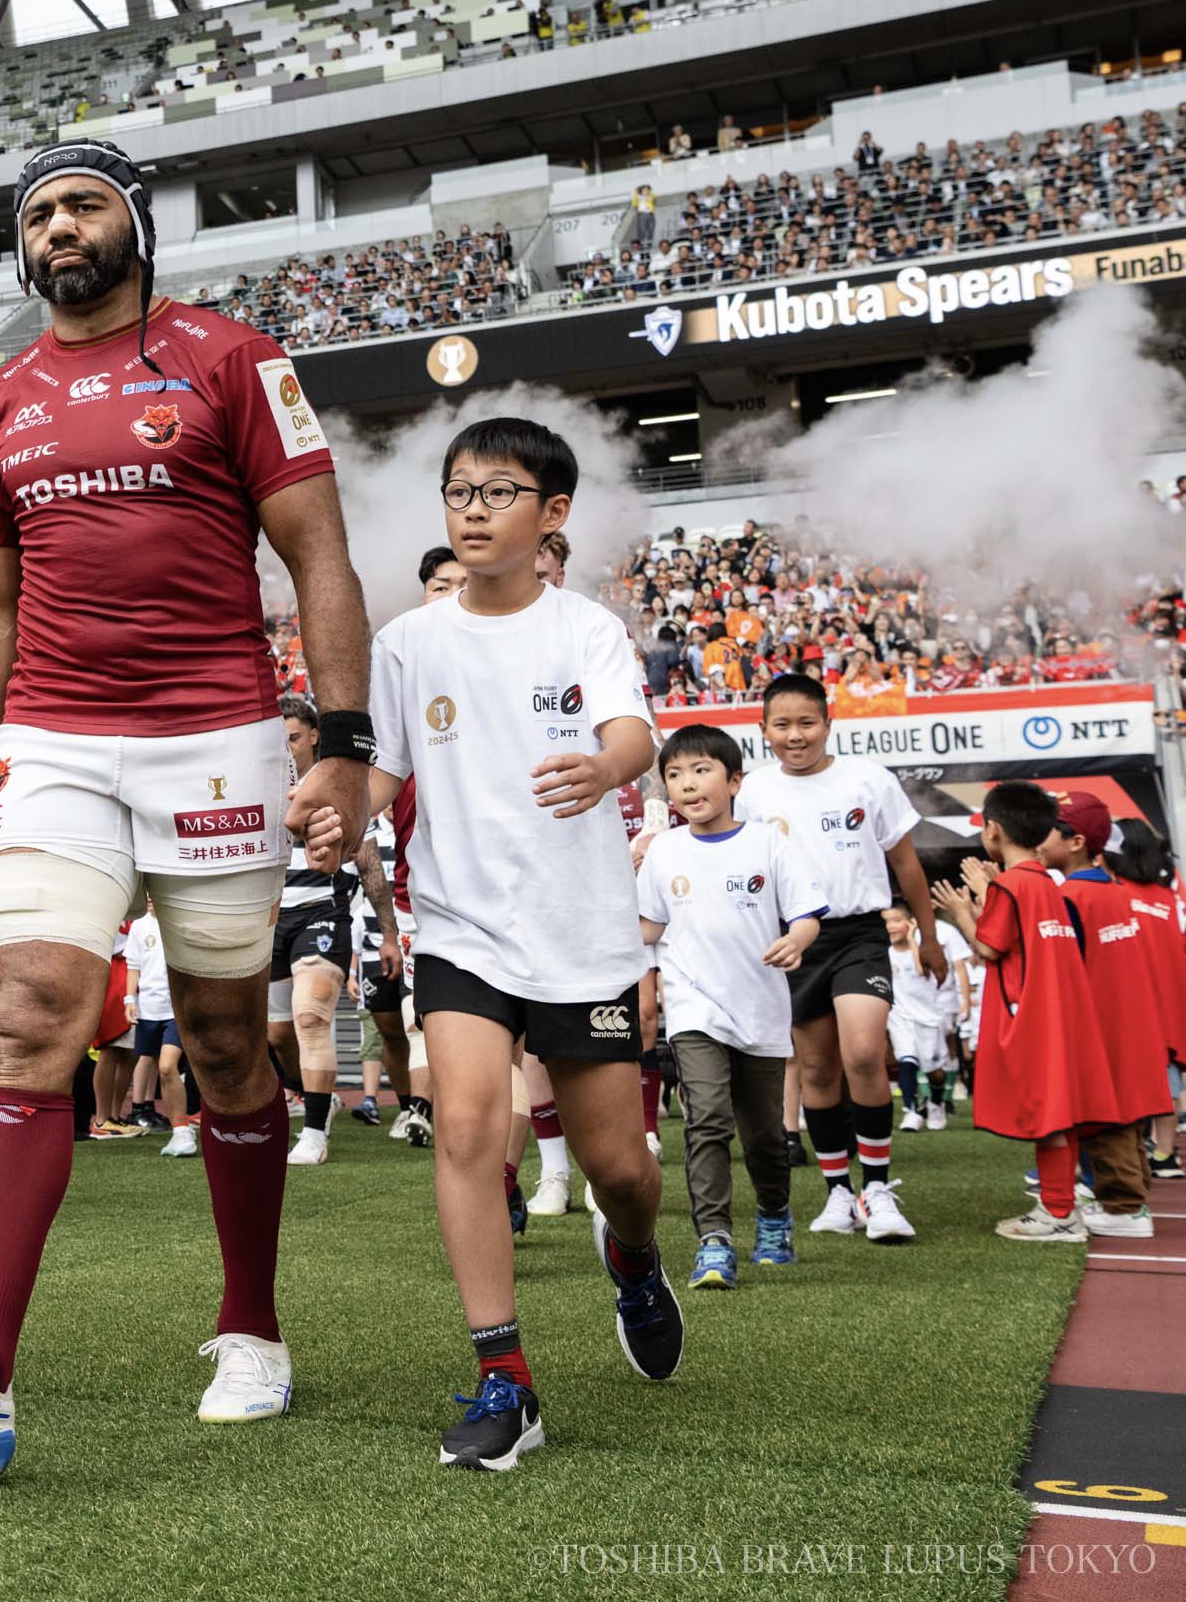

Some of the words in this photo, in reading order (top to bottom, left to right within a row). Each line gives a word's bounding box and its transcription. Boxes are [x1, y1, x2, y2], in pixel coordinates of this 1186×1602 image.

[717, 281, 886, 342] Kubota
[896, 257, 1074, 323] Spears
[67, 392, 111, 408] canterbury
[292, 413, 312, 431] ONE
[15, 463, 175, 511] TOSHIBA
[533, 696, 557, 713] ONE
[560, 729, 579, 738] NTT
[1071, 717, 1129, 740] NTT
[836, 728, 923, 756] LEAGUE
[931, 722, 983, 755] ONE
[182, 811, 260, 832] MS&AD
[821, 817, 842, 832] ONE
[178, 840, 268, 861] 三井住友海上
[726, 879, 745, 892] ONE
[590, 1030, 631, 1040] canterbury
[245, 1402, 275, 1414] MENACE
